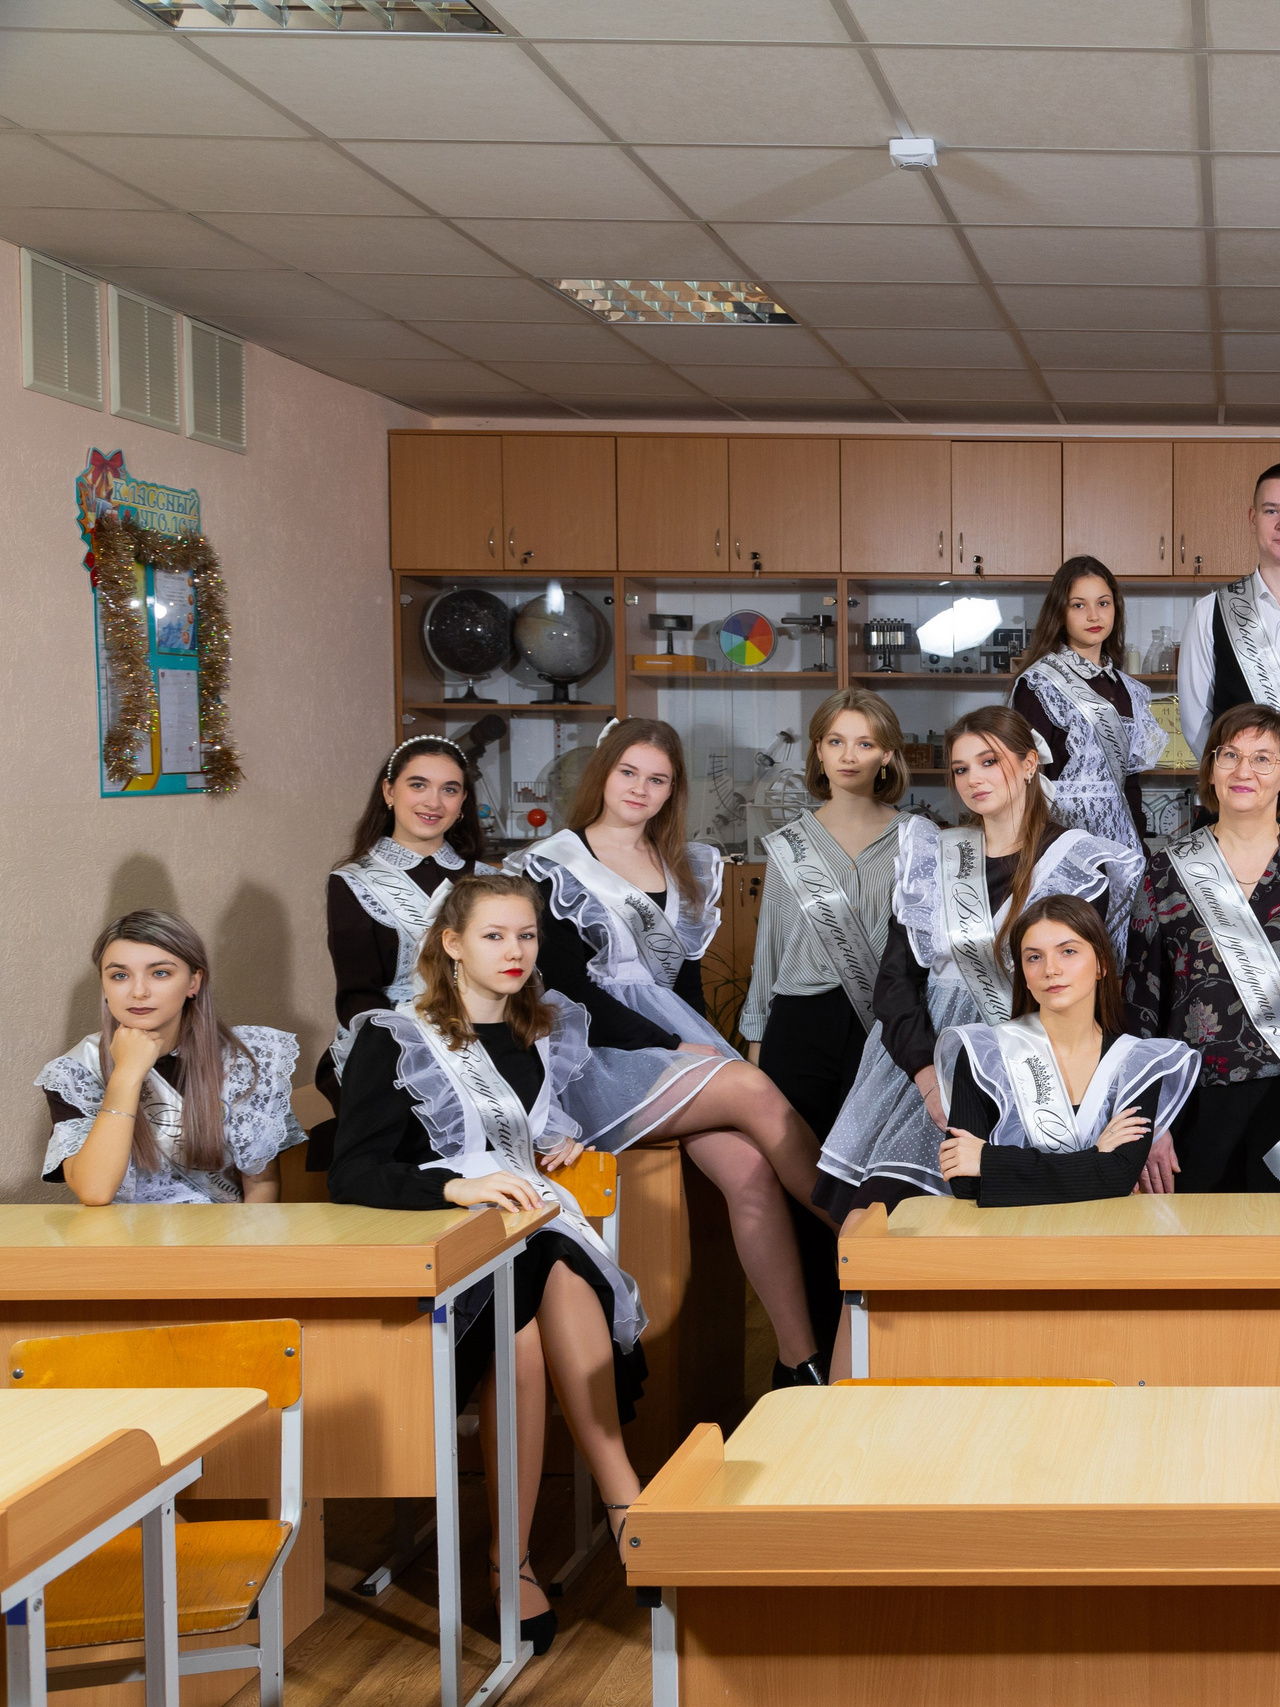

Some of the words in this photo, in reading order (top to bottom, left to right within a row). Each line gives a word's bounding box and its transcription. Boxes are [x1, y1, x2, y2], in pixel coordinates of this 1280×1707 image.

[112, 481, 198, 517] КЛАССНЫЙ
[793, 864, 873, 993] Выпускница
[1184, 861, 1237, 929] Классный
[1212, 924, 1277, 1021] руководитель
